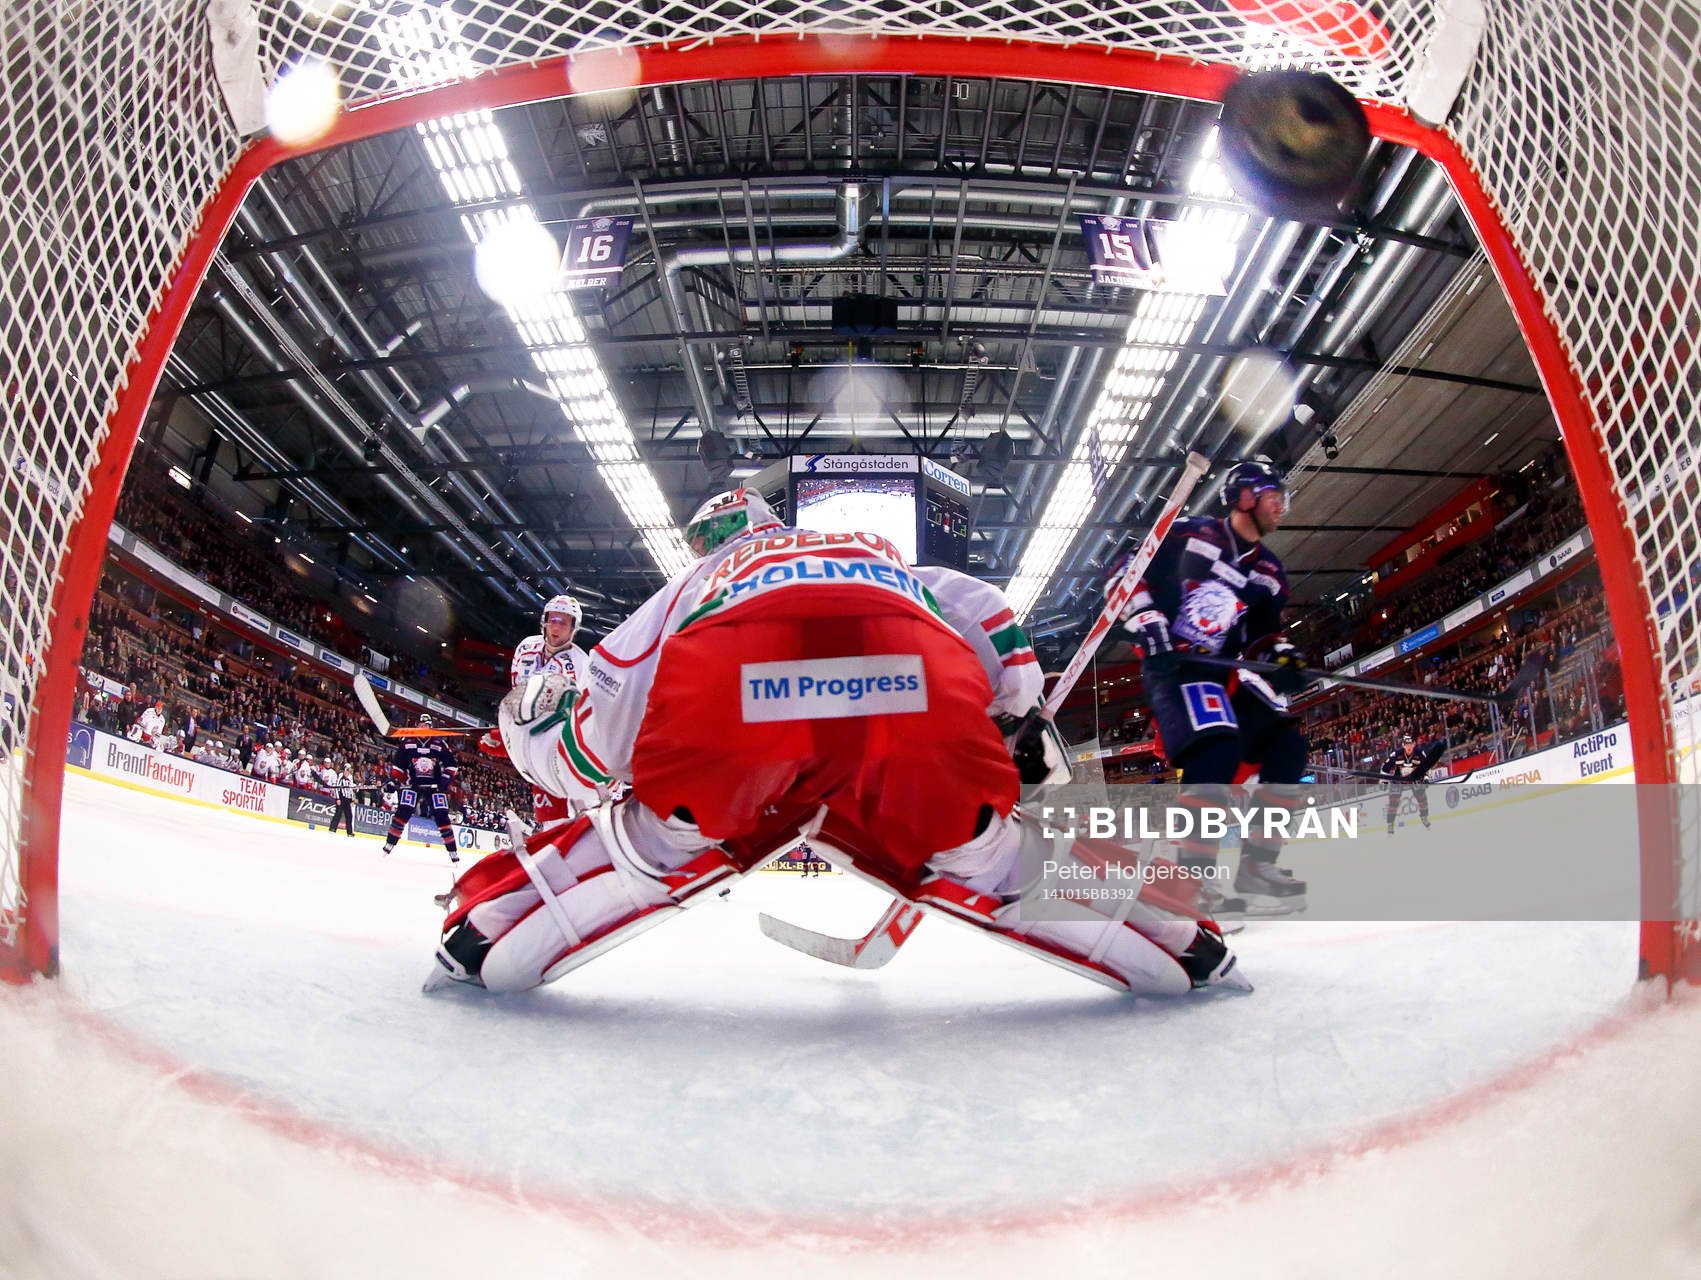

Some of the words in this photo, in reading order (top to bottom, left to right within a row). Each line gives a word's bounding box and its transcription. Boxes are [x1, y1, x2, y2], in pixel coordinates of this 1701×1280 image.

[577, 235, 614, 263] 16
[1099, 233, 1135, 261] 15
[823, 456, 909, 472] Stångåstaden
[923, 461, 969, 495] Corren
[730, 560, 923, 602] HOLMEN
[749, 677, 790, 700] TM
[798, 674, 919, 701] Progress
[1573, 733, 1617, 758] ActiPro
[107, 742, 195, 793] BrandFactory
[1580, 753, 1613, 777] Event
[240, 778, 267, 797] TEAM
[1461, 782, 1493, 801] SAAB
[1499, 769, 1542, 791] ARENA
[222, 789, 265, 813] SPORTIA
